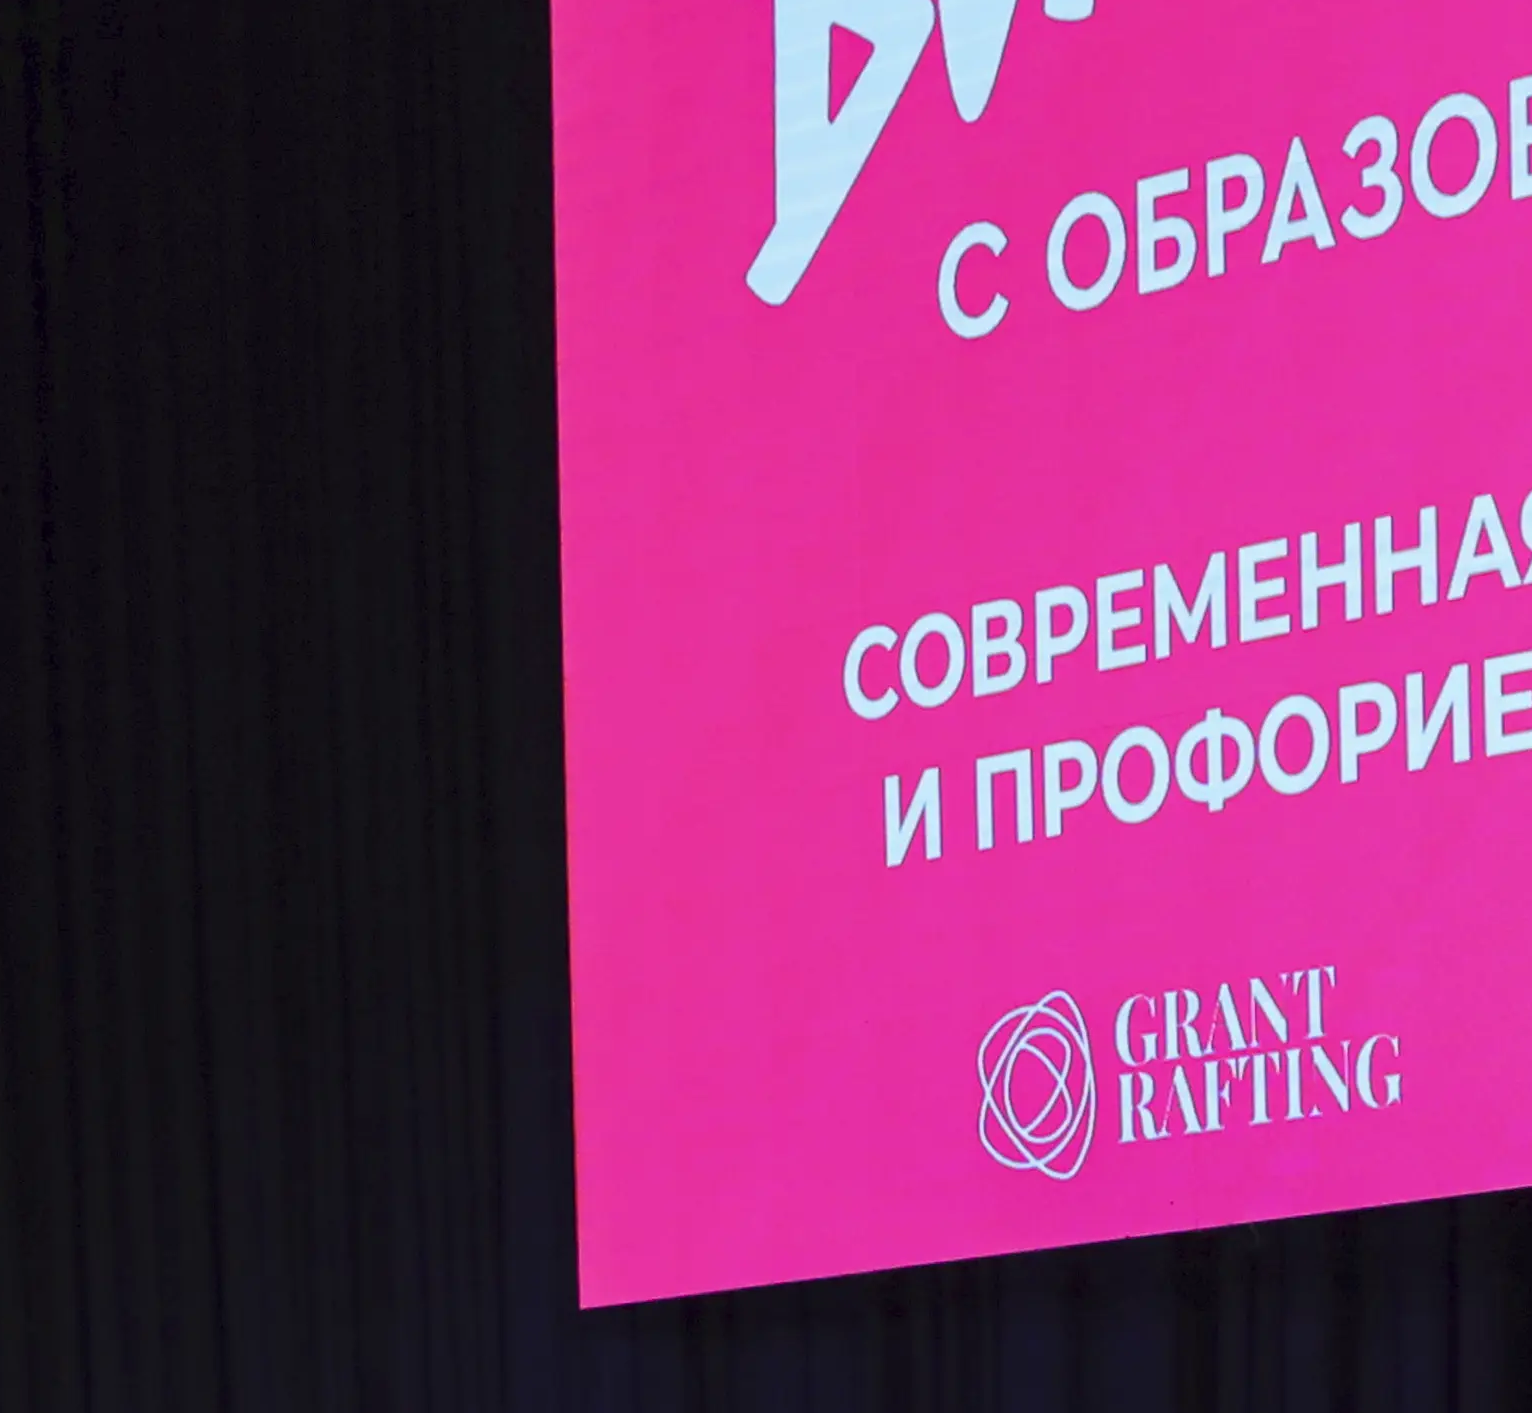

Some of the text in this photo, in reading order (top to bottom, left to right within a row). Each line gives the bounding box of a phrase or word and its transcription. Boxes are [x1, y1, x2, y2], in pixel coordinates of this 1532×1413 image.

[938, 222, 1008, 339] С
[884, 766, 942, 868] И
[1115, 964, 1336, 1068] GRANT
[1118, 1034, 1403, 1144] RAFTING
